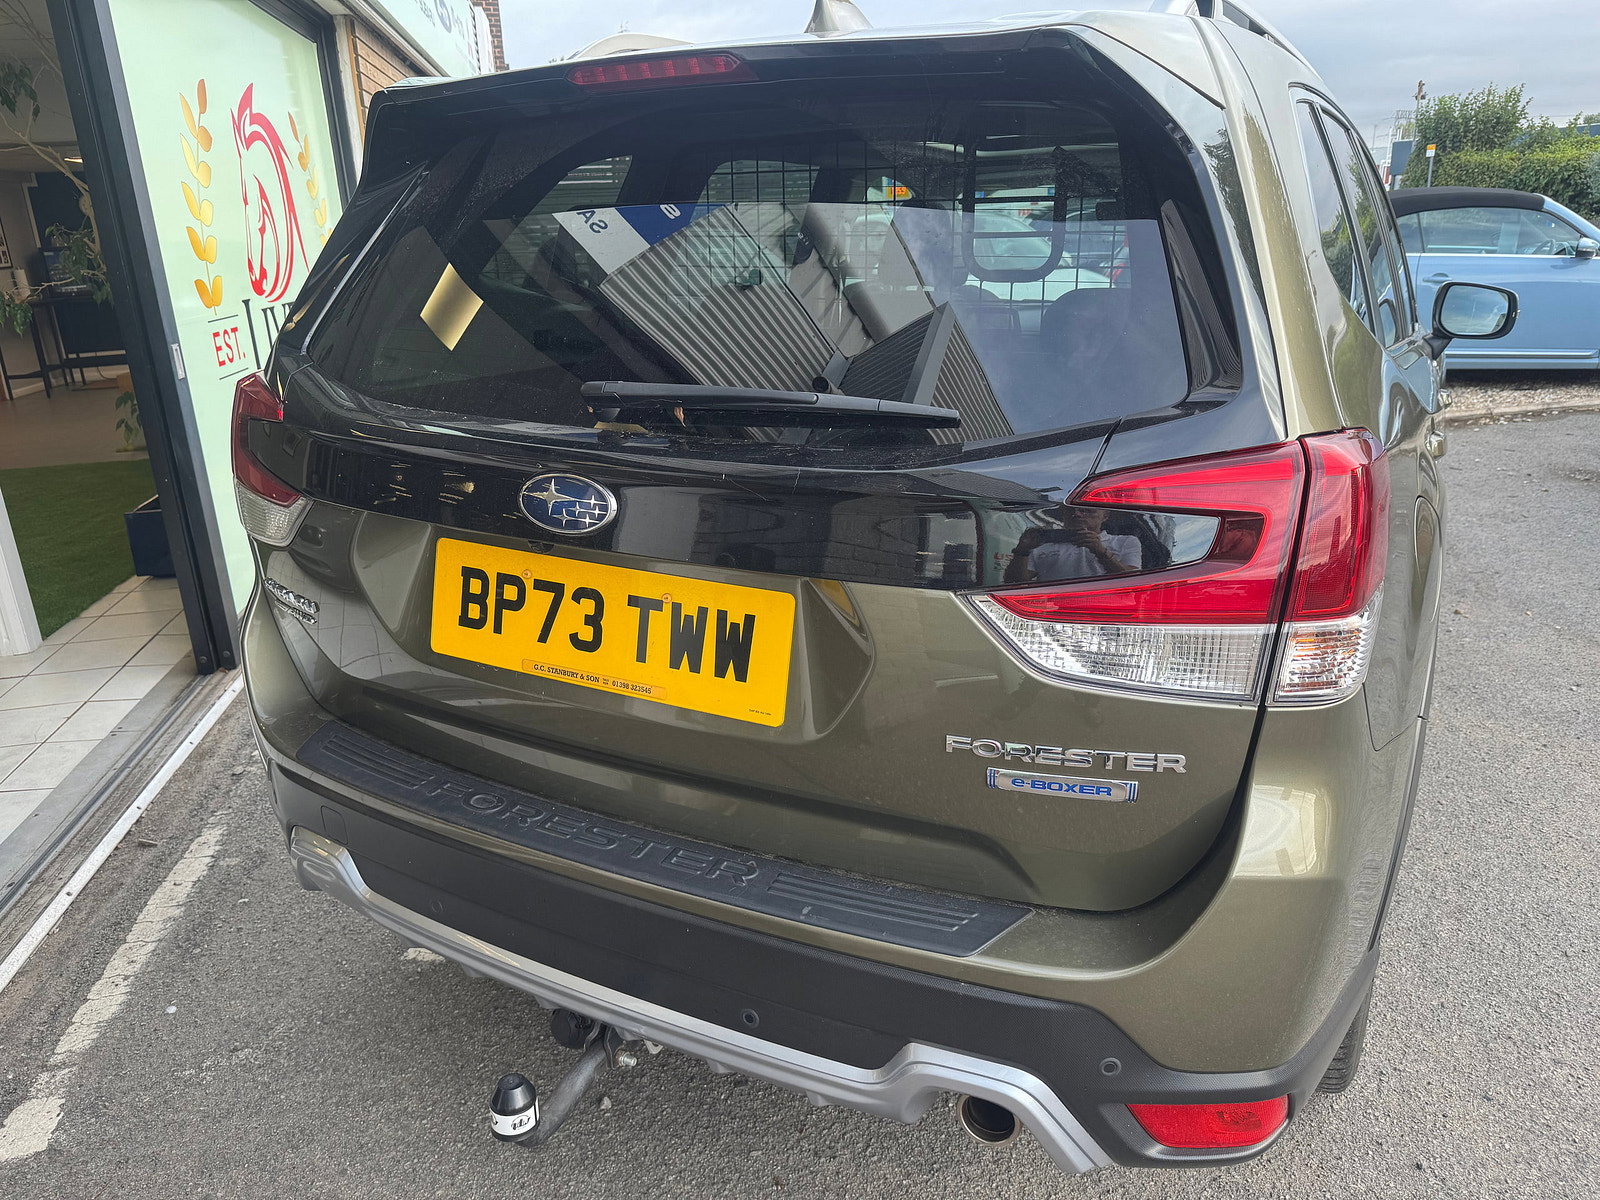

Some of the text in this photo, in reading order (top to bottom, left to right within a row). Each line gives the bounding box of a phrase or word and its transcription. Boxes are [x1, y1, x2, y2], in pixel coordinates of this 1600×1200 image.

[212, 326, 247, 367] EST.
[458, 565, 756, 683] BP73 TWW
[533, 663, 546, 673] G.C.
[547, 666, 579, 679] STANBURY
[585, 673, 600, 683] SON
[945, 734, 1187, 773] FORESTER
[1011, 777, 1112, 796] e-BOXER
[426, 782, 759, 887] FORESTER
